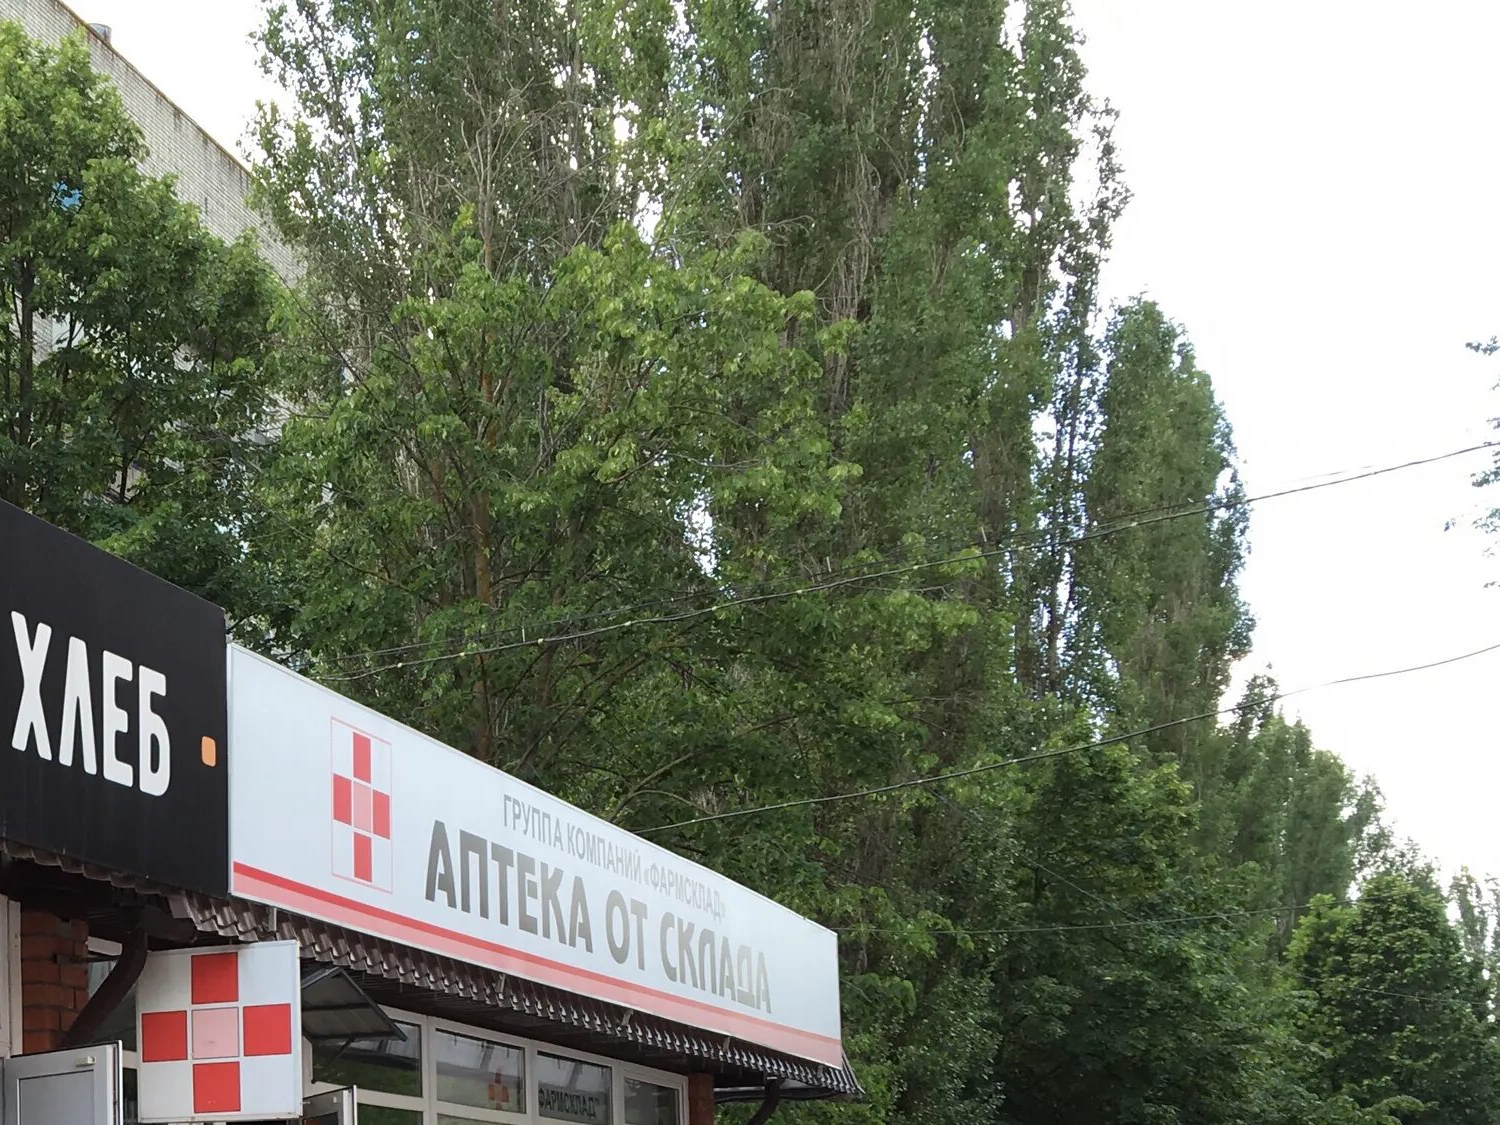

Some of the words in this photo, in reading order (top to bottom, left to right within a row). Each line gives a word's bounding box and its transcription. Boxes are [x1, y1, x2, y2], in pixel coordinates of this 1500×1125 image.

[10, 610, 171, 797] ХЛЕБ
[425, 820, 593, 954] АПТЕКА
[605, 889, 648, 971] ОТ
[659, 911, 772, 1014] СКЛАДА
[503, 794, 564, 852] ГРУППА
[566, 822, 642, 885] КОМПАНИЙ
[643, 861, 727, 924] «ФАРМСКЛАД»
